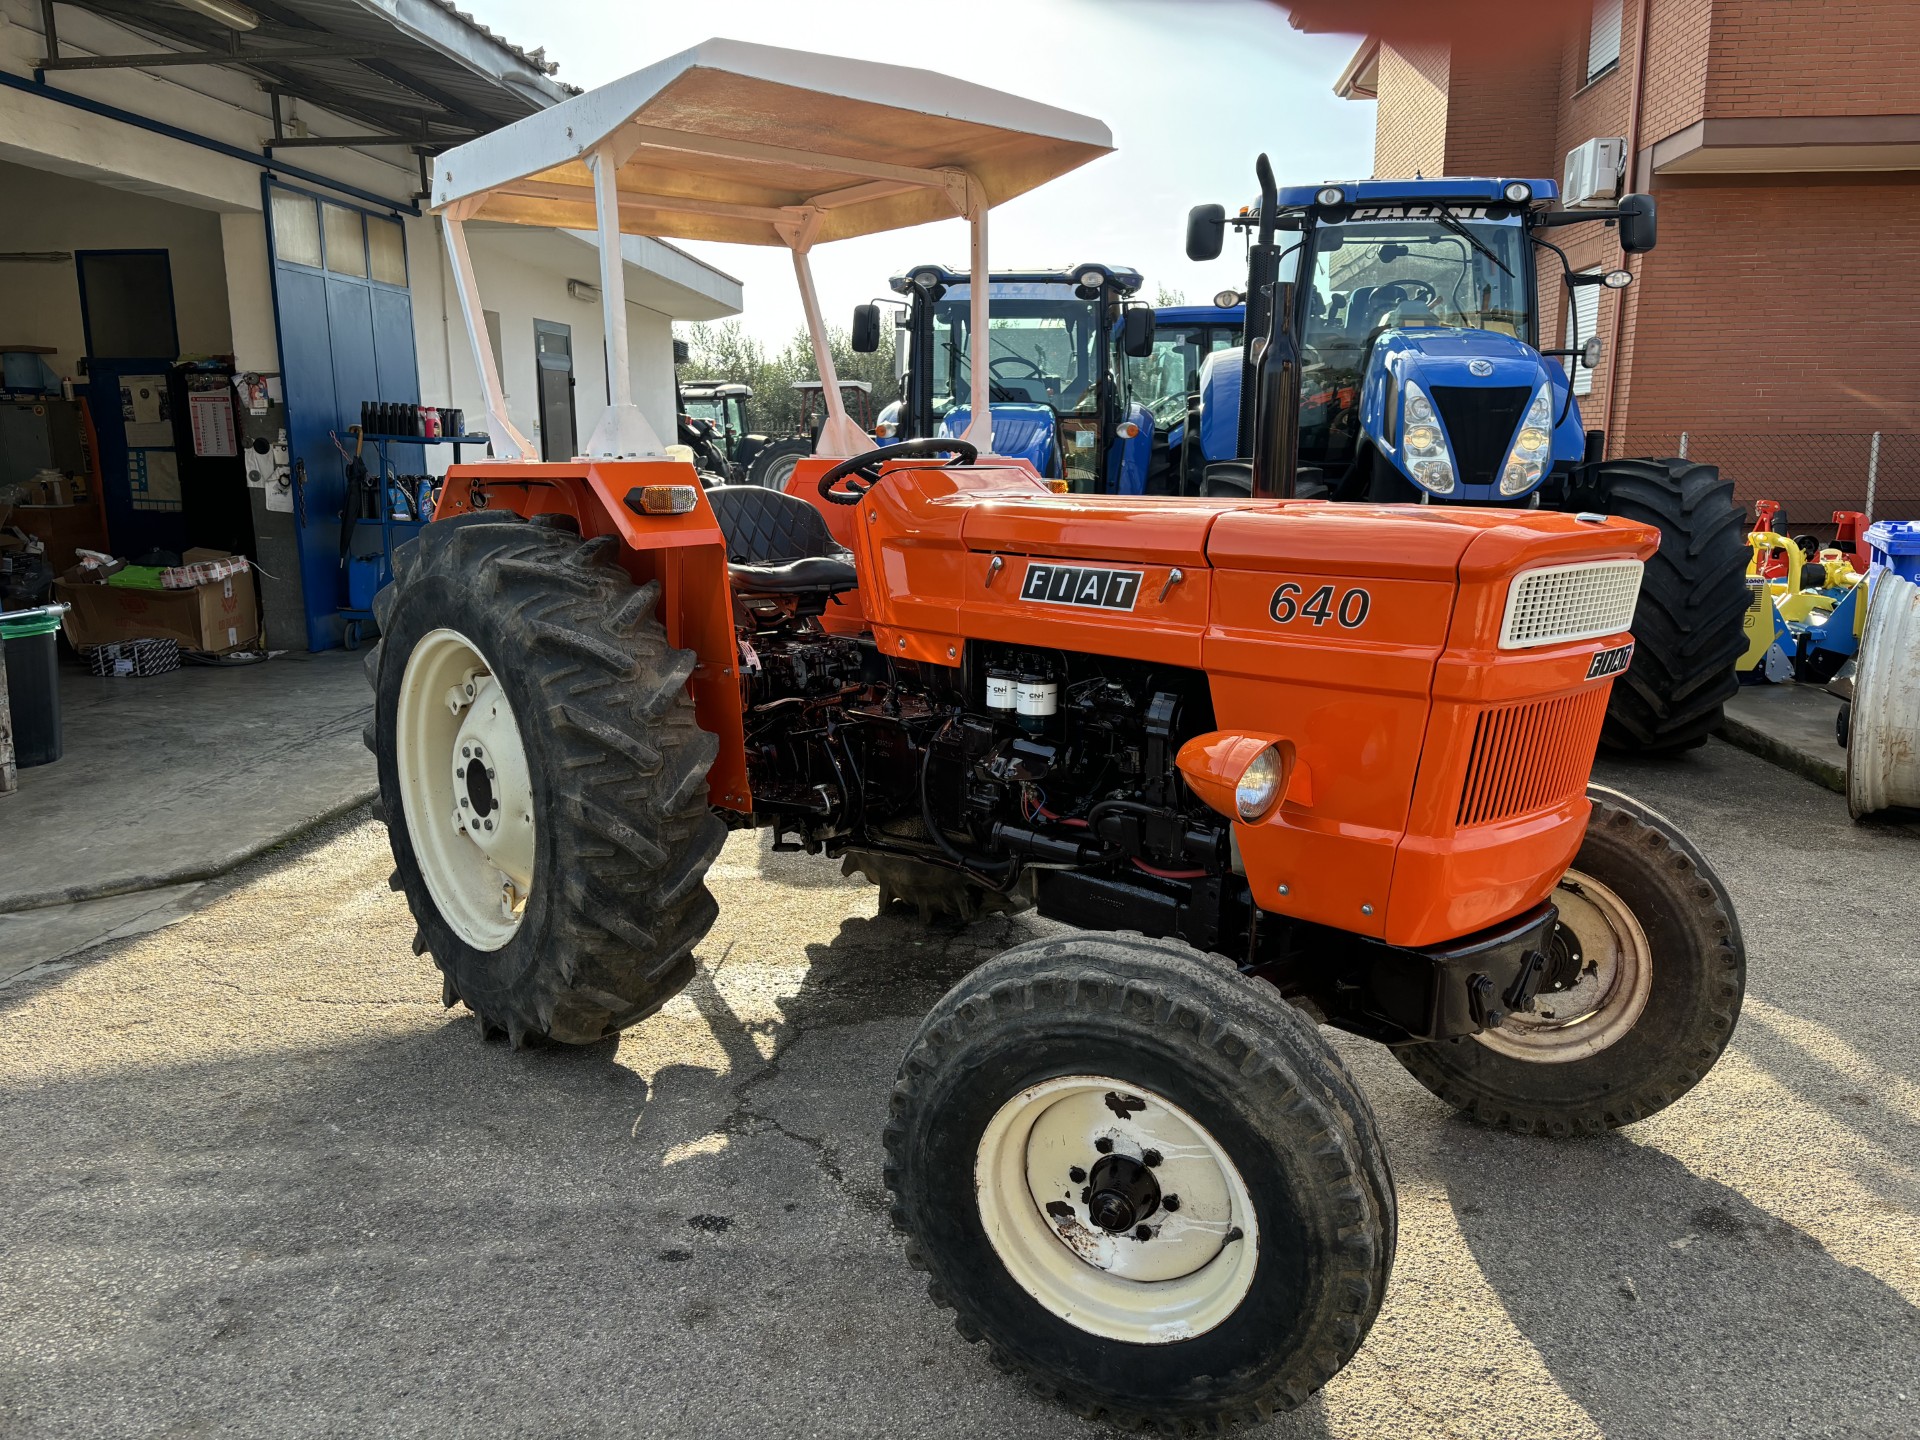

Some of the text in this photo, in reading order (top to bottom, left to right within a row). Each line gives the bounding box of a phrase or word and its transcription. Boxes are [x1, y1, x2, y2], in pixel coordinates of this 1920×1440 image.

[1351, 207, 1487, 220] PACINI
[1028, 571, 1134, 604] FIAT
[1268, 581, 1372, 630] 640
[1589, 648, 1631, 675] FIAT
